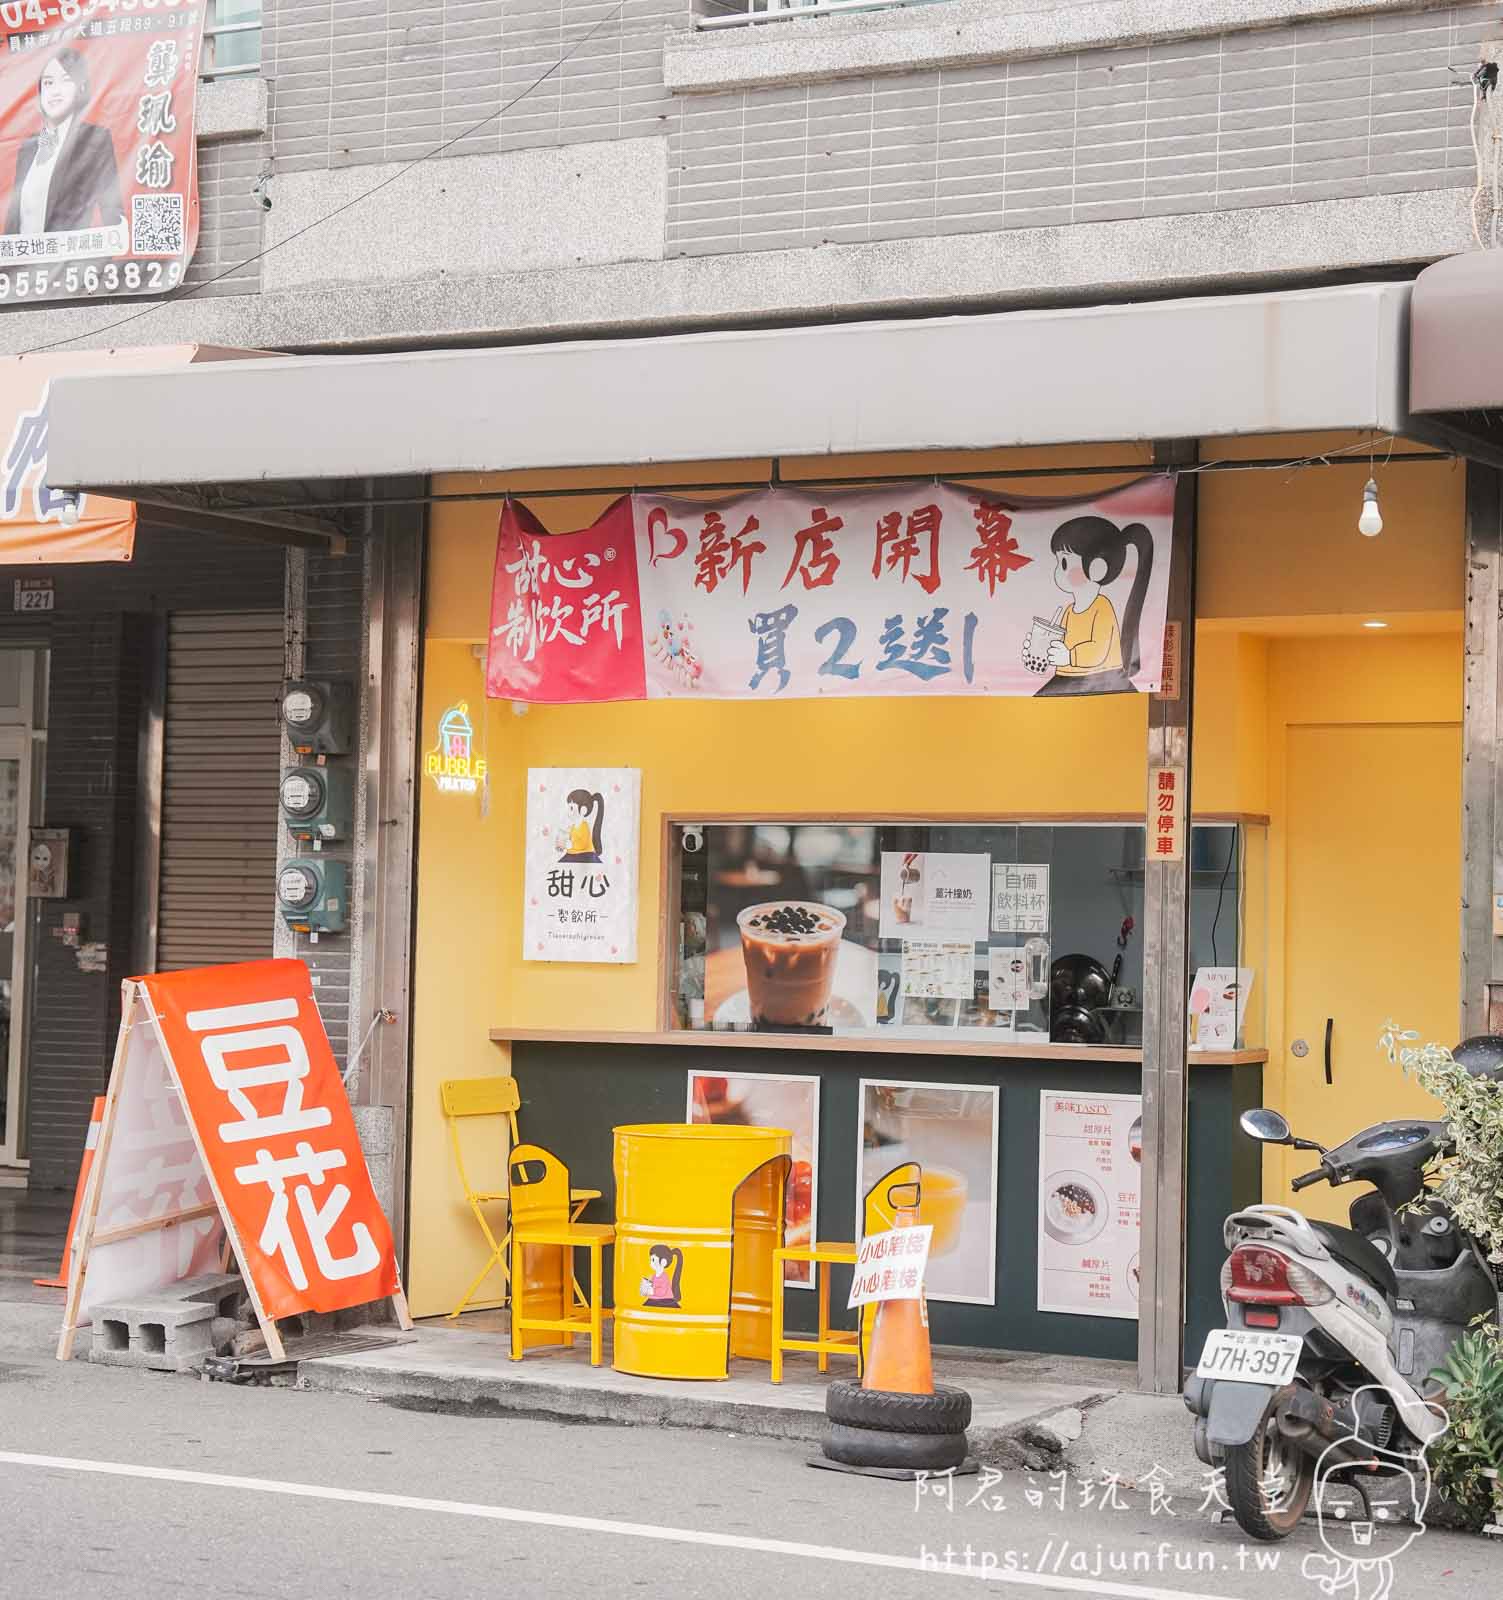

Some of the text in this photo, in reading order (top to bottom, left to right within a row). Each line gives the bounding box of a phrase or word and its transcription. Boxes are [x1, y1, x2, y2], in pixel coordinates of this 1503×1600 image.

[694, 500, 1034, 598] 新店開幕
[25, 591, 50, 609] 221
[748, 604, 978, 694] 買2送1
[429, 754, 487, 779] BUBBLE
[1155, 771, 1176, 855] 請勿停車
[546, 869, 610, 898] 甜心
[1005, 873, 1038, 890] 自備
[997, 892, 1046, 910] 飲料杯
[997, 913, 1044, 931] 省五元
[186, 997, 380, 1290] 豆花
[1203, 1347, 1295, 1377] J7H-397
